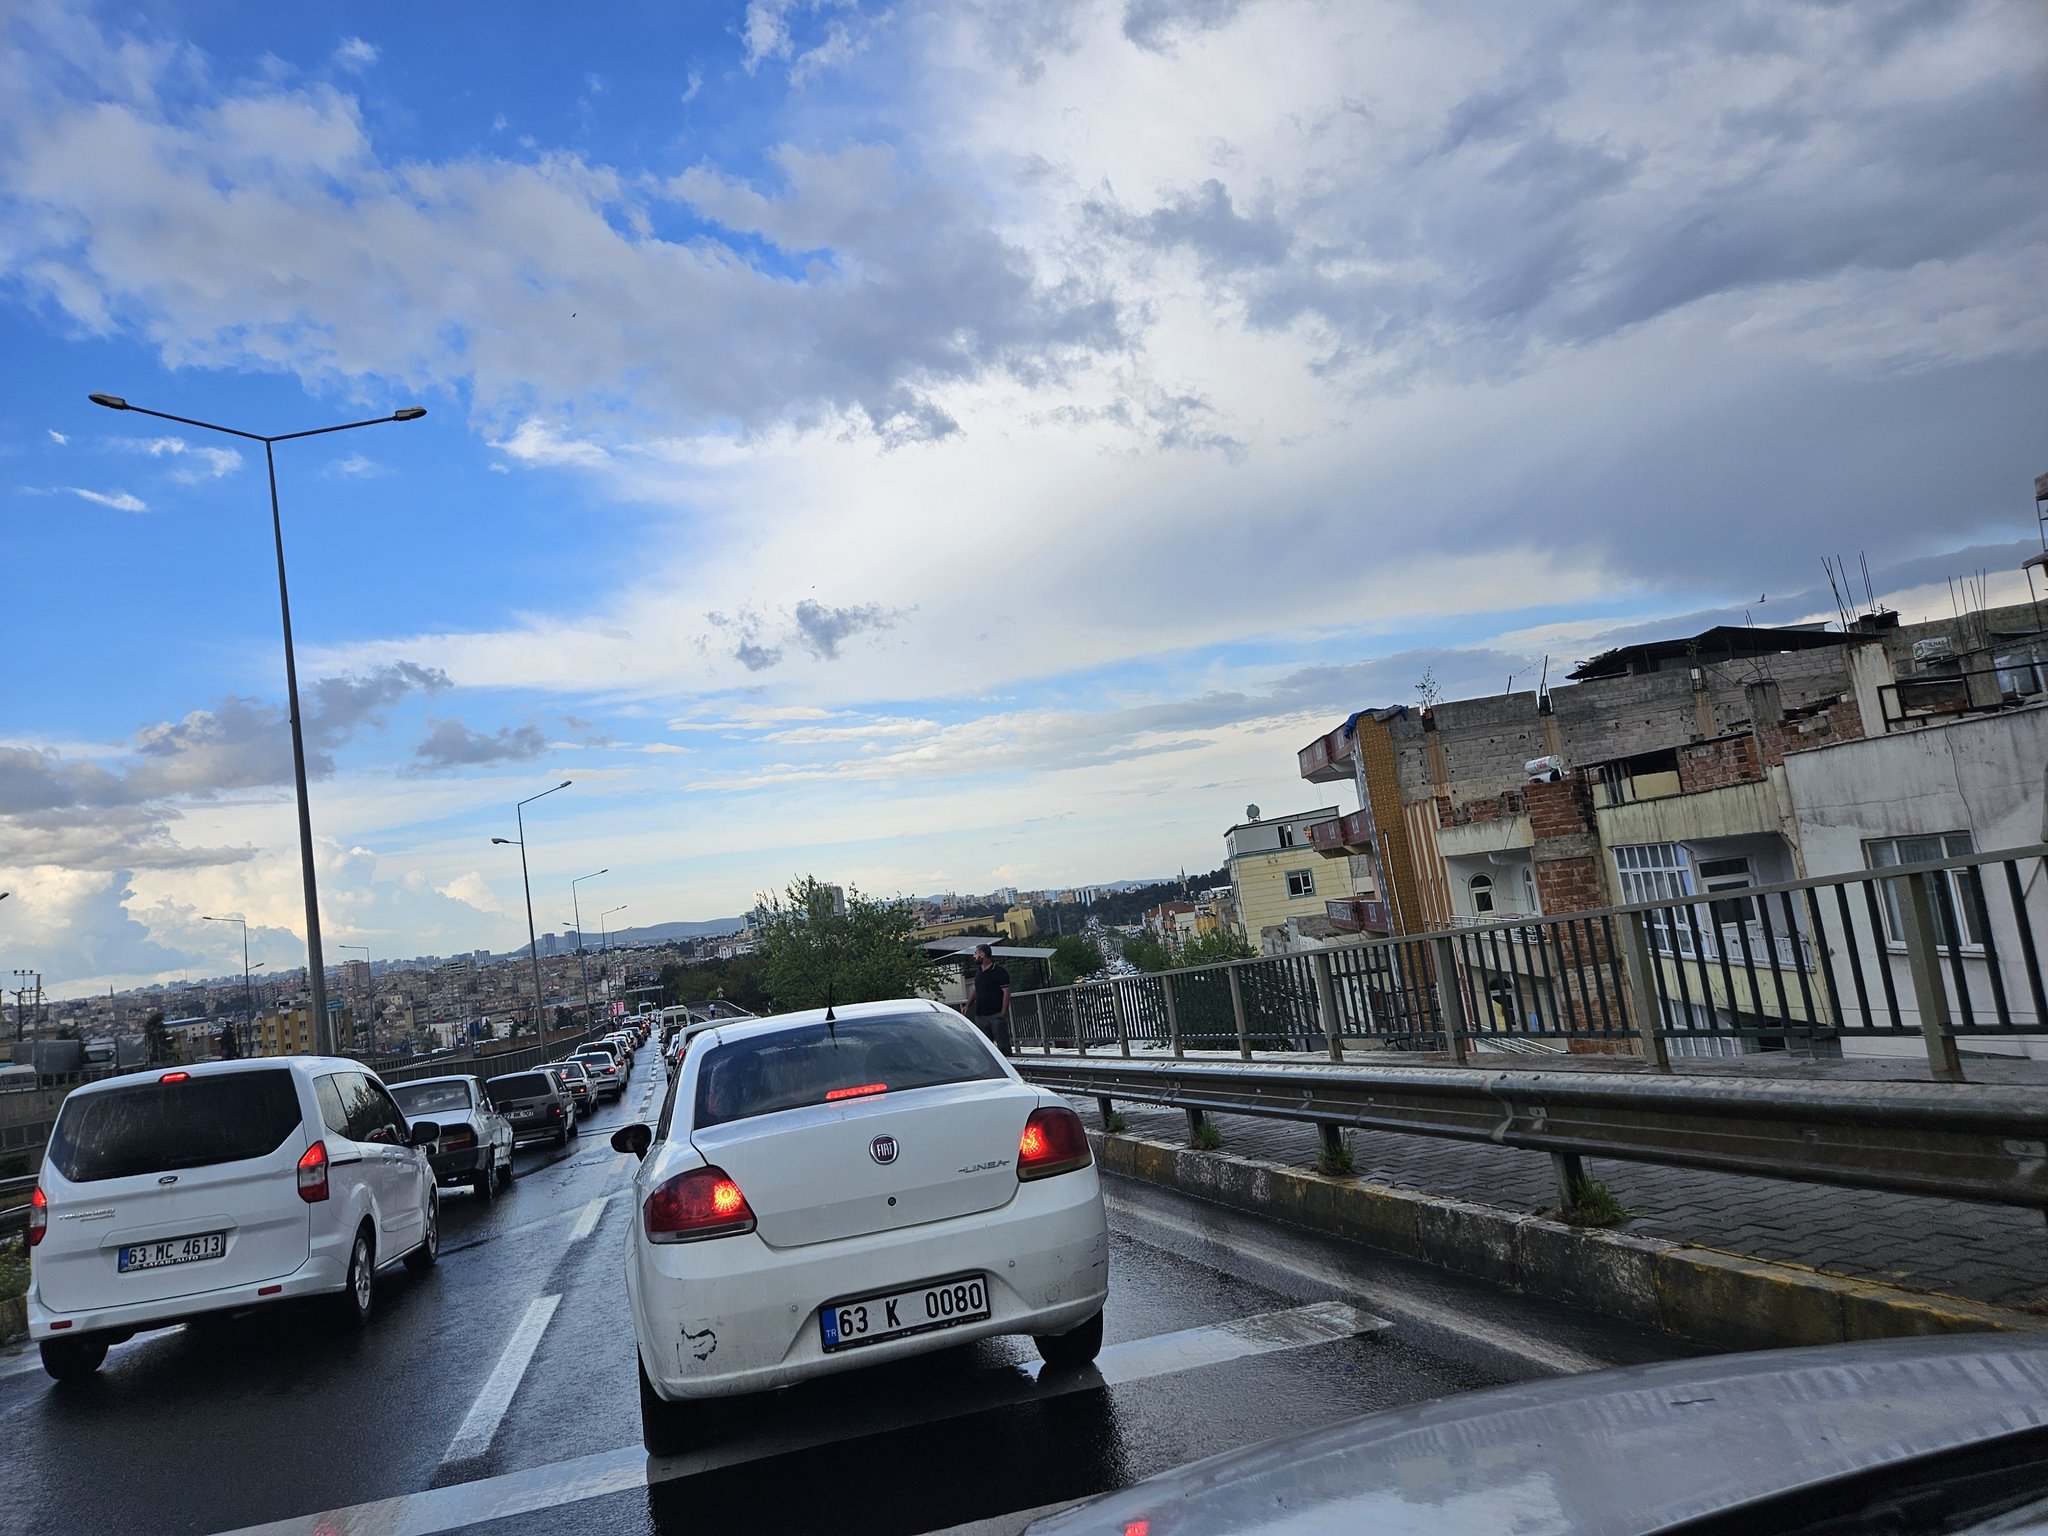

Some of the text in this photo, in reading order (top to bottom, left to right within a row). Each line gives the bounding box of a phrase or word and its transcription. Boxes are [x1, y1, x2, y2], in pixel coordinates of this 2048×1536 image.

[876, 1142, 893, 1157] FIAT
[958, 1159, 1010, 1173] LINEA
[129, 1248, 147, 1265] 63
[155, 1243, 174, 1261] MC
[182, 1236, 220, 1256] 4613
[175, 1255, 199, 1264] AUTO
[826, 1282, 983, 1338] TR 63 K 0080
